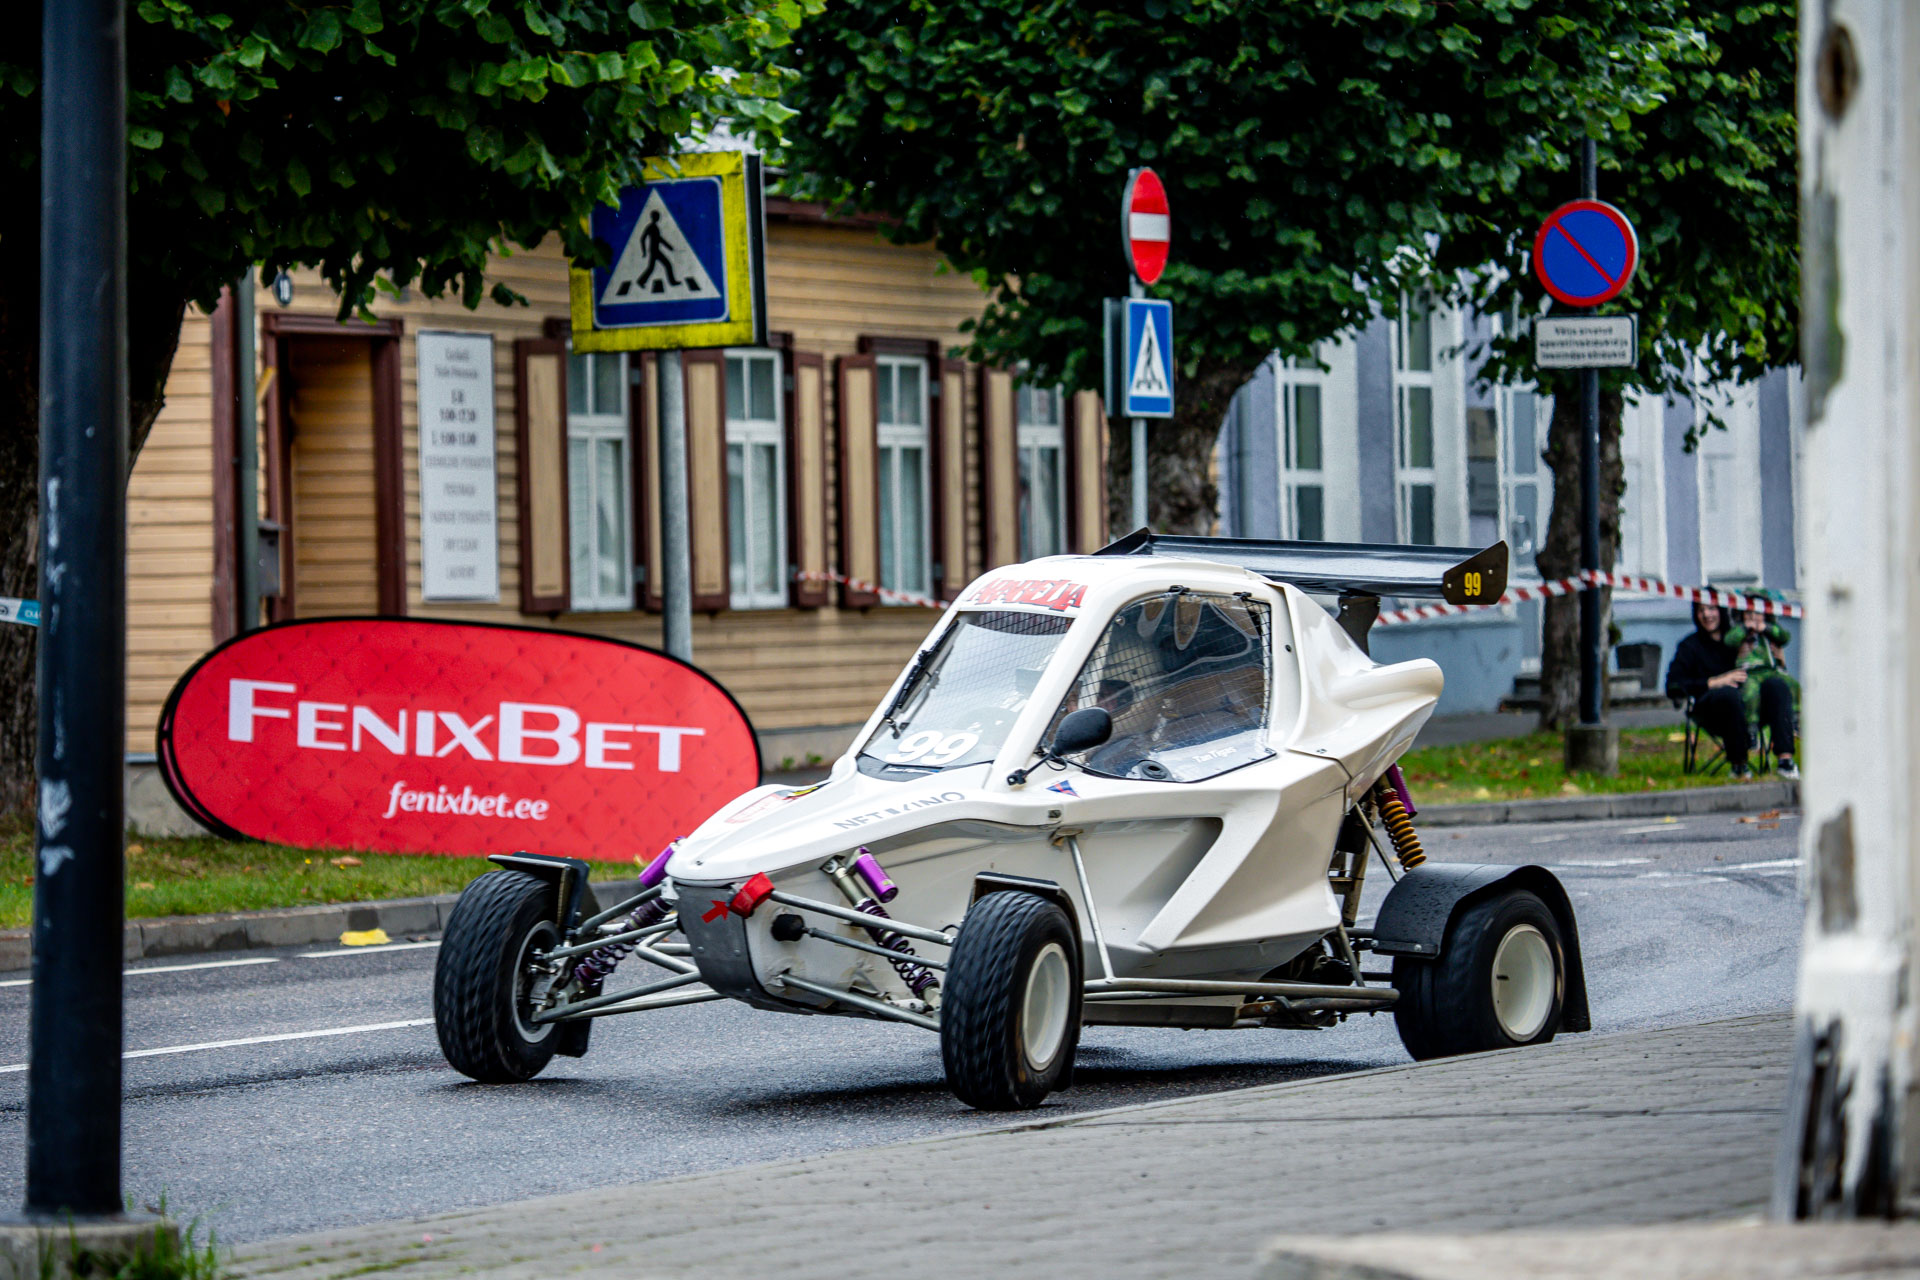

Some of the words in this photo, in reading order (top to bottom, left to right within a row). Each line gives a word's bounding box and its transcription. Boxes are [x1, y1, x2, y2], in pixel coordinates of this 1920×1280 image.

[1463, 571, 1482, 597] 99
[885, 730, 979, 766] 99
[382, 780, 549, 821] fenixbet.ee
